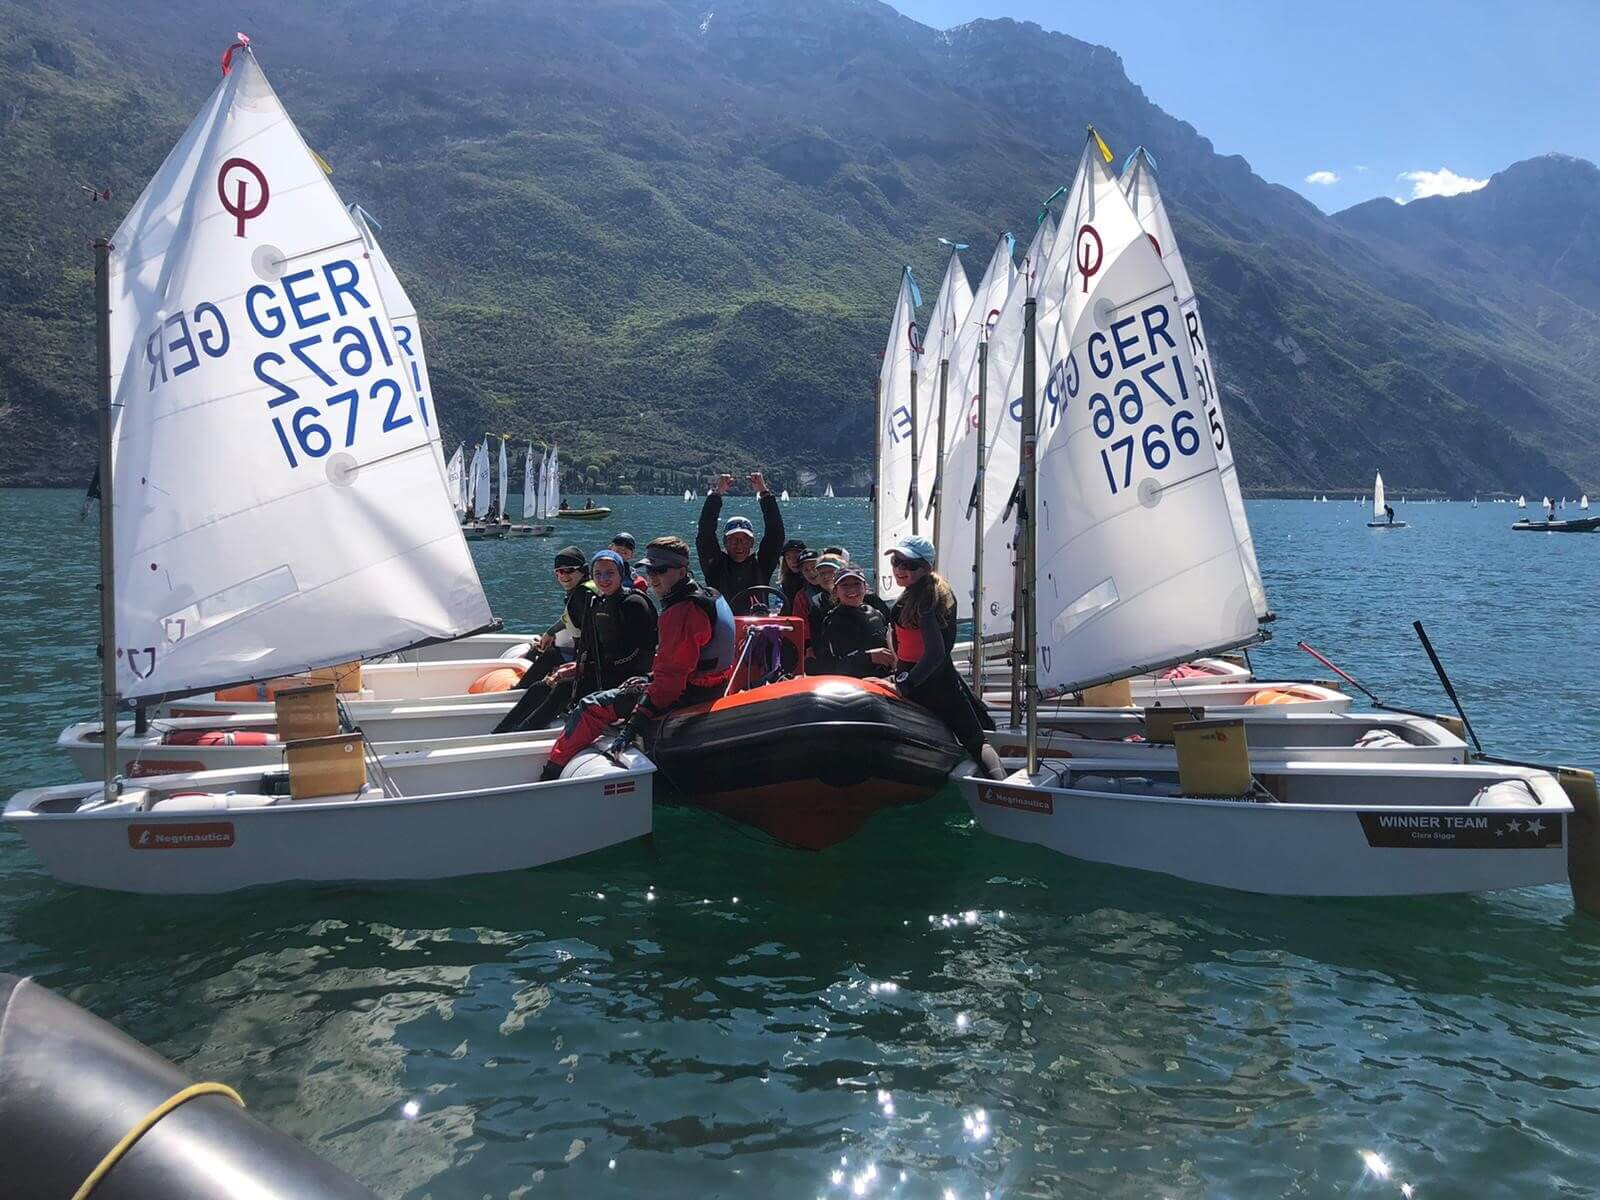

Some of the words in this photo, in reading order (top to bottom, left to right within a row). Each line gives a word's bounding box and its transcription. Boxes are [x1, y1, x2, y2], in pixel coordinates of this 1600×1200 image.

[246, 259, 371, 339] GER
[1088, 304, 1177, 379] GER
[271, 378, 413, 469] 1672
[1101, 410, 1201, 495] 1766
[155, 832, 231, 844] Negrinautica
[1379, 816, 1441, 828] WINNER
[1444, 816, 1489, 828] TEAM
